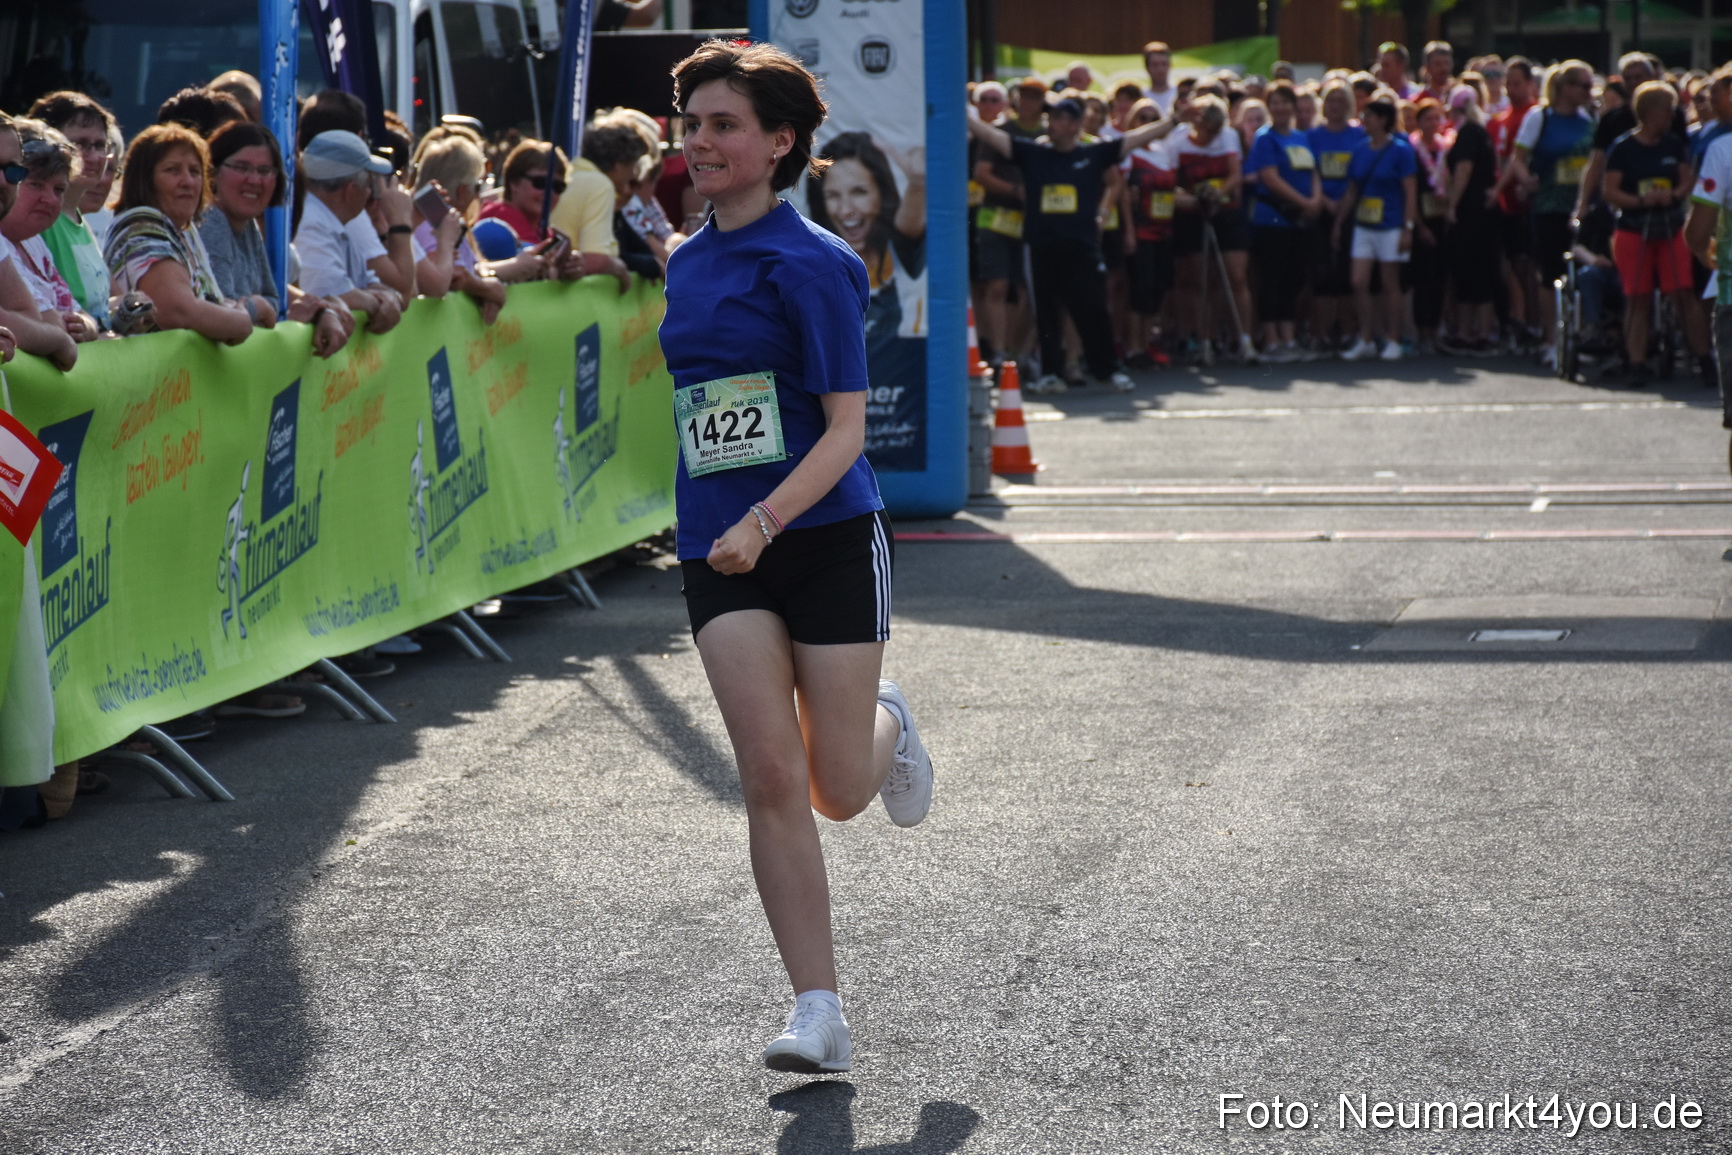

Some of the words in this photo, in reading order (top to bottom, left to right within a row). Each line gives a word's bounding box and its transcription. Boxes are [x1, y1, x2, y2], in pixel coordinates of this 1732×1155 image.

[747, 396, 769, 406] 2019
[688, 406, 766, 450] 1422
[695, 455, 721, 467] Lebenshilfe
[721, 451, 751, 461] Neumarkt
[700, 447, 720, 459] Meyer
[722, 442, 754, 454] Sandra
[246, 470, 323, 596] firmenlauf
[40, 516, 112, 652] rmenlauf
